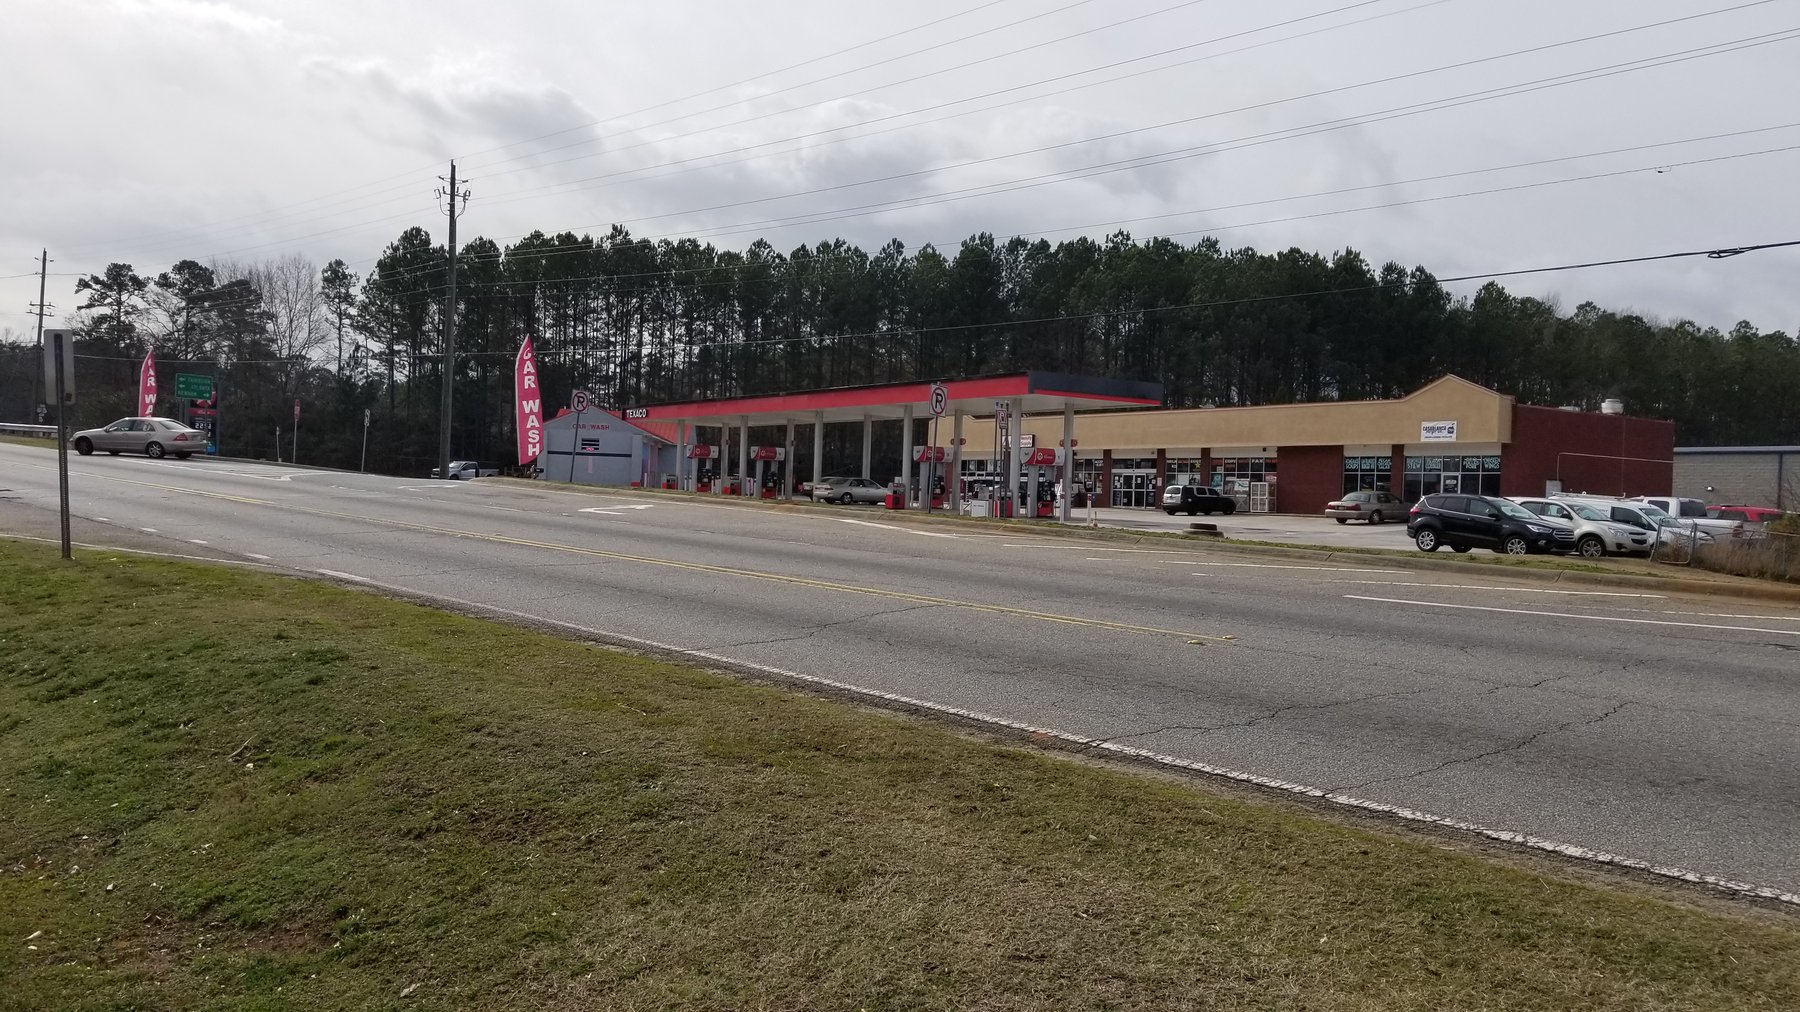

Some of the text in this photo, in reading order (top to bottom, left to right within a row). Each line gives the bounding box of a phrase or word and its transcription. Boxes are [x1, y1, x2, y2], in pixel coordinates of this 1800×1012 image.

[522, 348, 540, 456] CAR WASH
[626, 409, 647, 418] TEXACO
